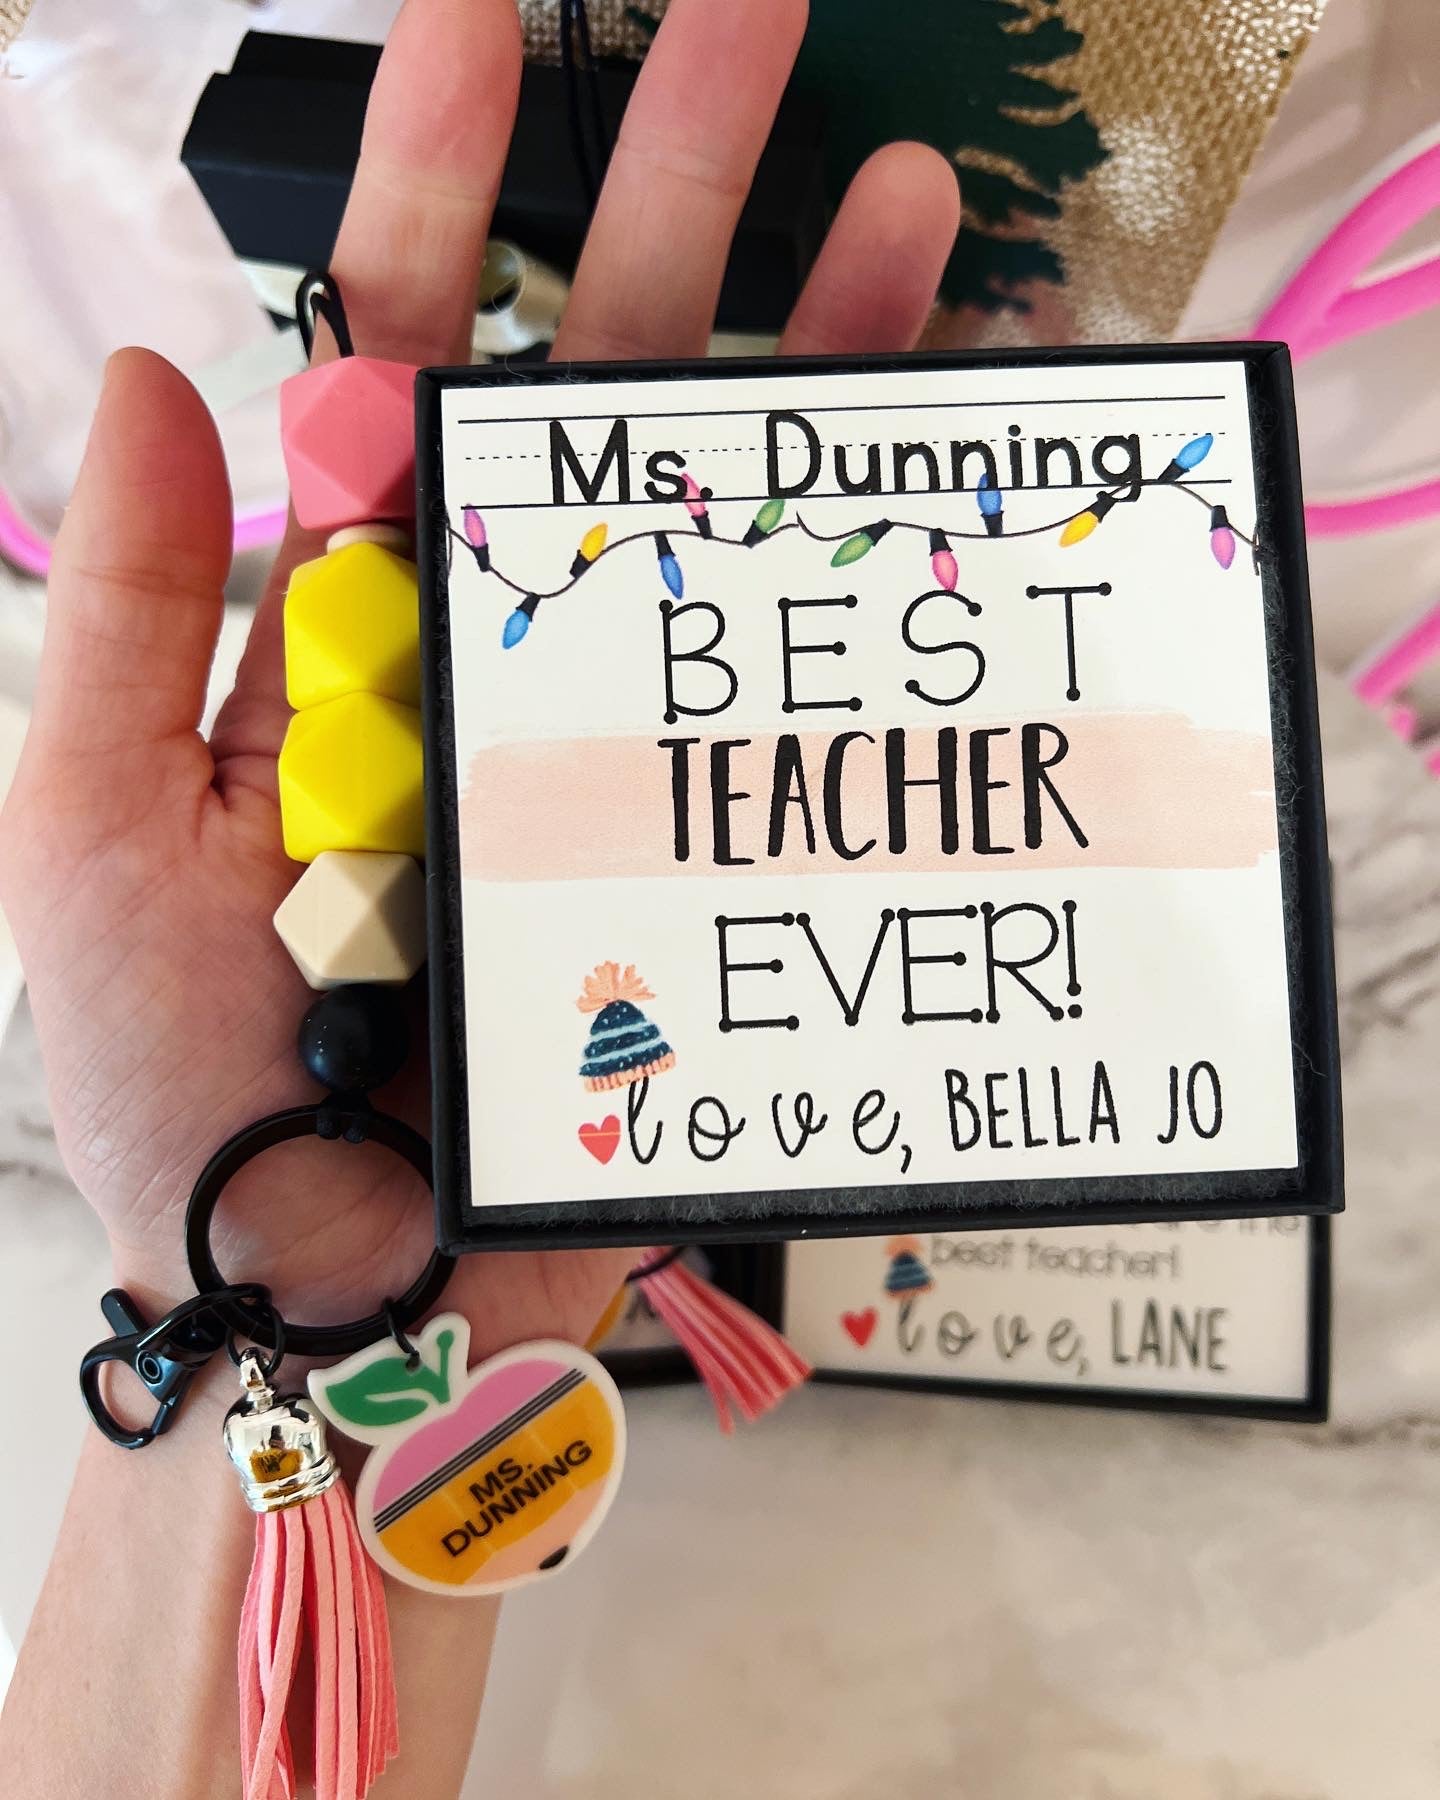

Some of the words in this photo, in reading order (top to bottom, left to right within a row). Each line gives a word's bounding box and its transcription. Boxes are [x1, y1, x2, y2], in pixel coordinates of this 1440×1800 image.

[549, 418, 713, 506] Ms.
[767, 411, 1143, 503] Dunning
[660, 581, 1113, 724] BEST
[657, 722, 1090, 866] TEACHER
[714, 899, 1083, 1034] EVER!
[627, 1076, 912, 1174] love,
[944, 1060, 1121, 1152] BELLA
[1156, 1060, 1224, 1146] JO
[930, 1233, 1015, 1271] best
[897, 1296, 1091, 1377] love,
[1110, 1296, 1229, 1372] LANE
[440, 1439, 593, 1558] DUNNING
[468, 1457, 534, 1505] MS.
